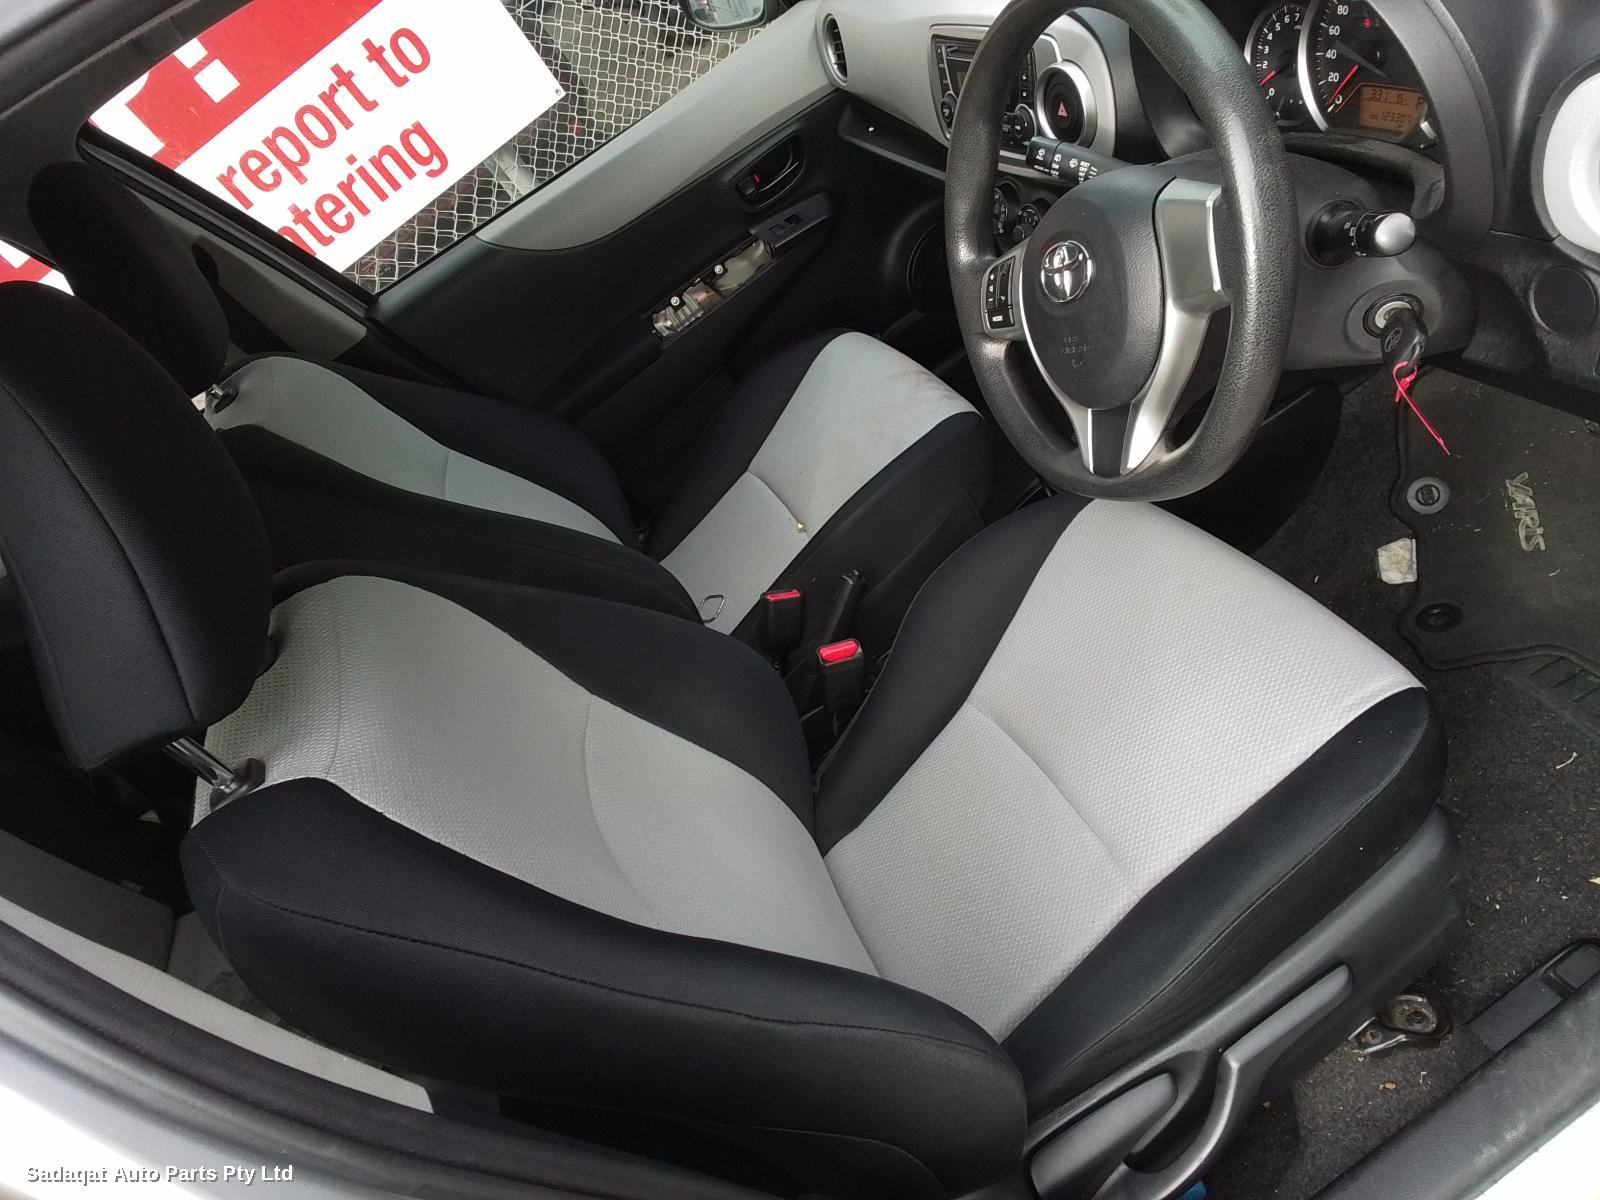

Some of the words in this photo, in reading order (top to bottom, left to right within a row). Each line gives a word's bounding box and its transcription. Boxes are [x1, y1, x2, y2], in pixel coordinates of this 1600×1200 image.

[1337, 5, 1349, 15] 80
[1284, 15, 1290, 23] 6
[1294, 13, 1300, 21] 7
[1275, 22, 1281, 31] 5
[1328, 25, 1341, 36] 60
[1266, 32, 1273, 41] 4
[1263, 45, 1270, 54] 3
[1325, 49, 1337, 59] 40
[1262, 60, 1268, 69] 2
[1328, 72, 1340, 83] 20
[1268, 87, 1275, 96] 0
[1335, 95, 1343, 104] 0
[217, 63, 379, 211] report
[362, 27, 431, 88] to
